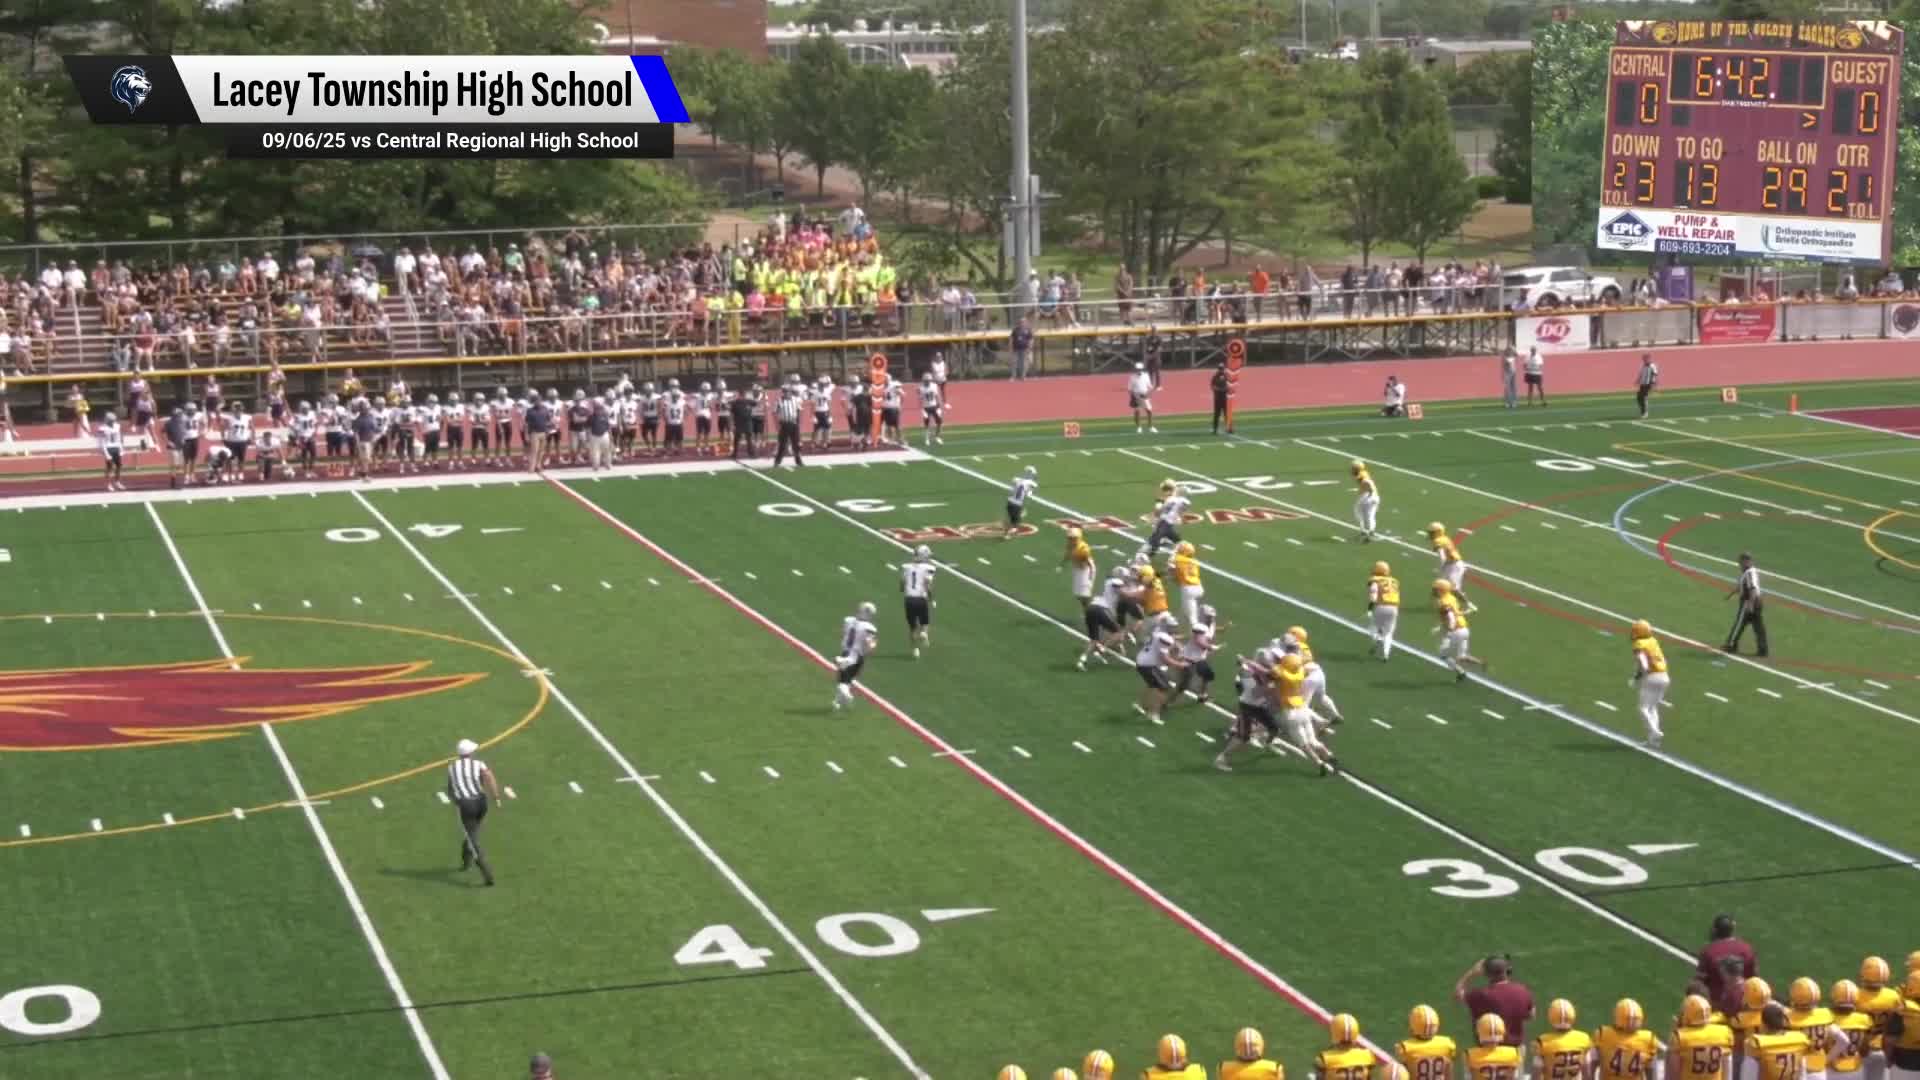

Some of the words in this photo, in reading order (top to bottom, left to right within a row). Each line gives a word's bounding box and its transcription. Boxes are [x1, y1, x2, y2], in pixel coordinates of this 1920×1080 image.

[1798, 24, 1837, 48] EAGLES
[1612, 54, 1666, 77] CENTRAL
[1831, 60, 1888, 85] GUEST
[1641, 83, 1659, 123] 0
[1859, 91, 1880, 132] 0
[1612, 133, 1660, 157] DOWN
[1676, 136, 1697, 159] TO
[1700, 137, 1723, 160] GO
[1757, 140, 1792, 163] BALL
[1796, 142, 1818, 164] ON
[1837, 143, 1870, 168] QTR
[1613, 162, 1626, 187] 2
[1637, 161, 1655, 202] 3
[1686, 164, 1719, 205] 13
[1762, 167, 1807, 208] 29
[1827, 170, 1848, 212] 2
[1612, 222, 1643, 236] EPIC
[1658, 226, 1688, 238] WELL
[1692, 228, 1735, 240] REPAIR
[1675, 215, 1707, 227] PUMP
[1711, 218, 1719, 227] &
[1541, 322, 1567, 337] DQ
[1402, 847, 1649, 898] 30
[673, 912, 921, 969] 40
[1609, 1047, 1642, 1076] 44
